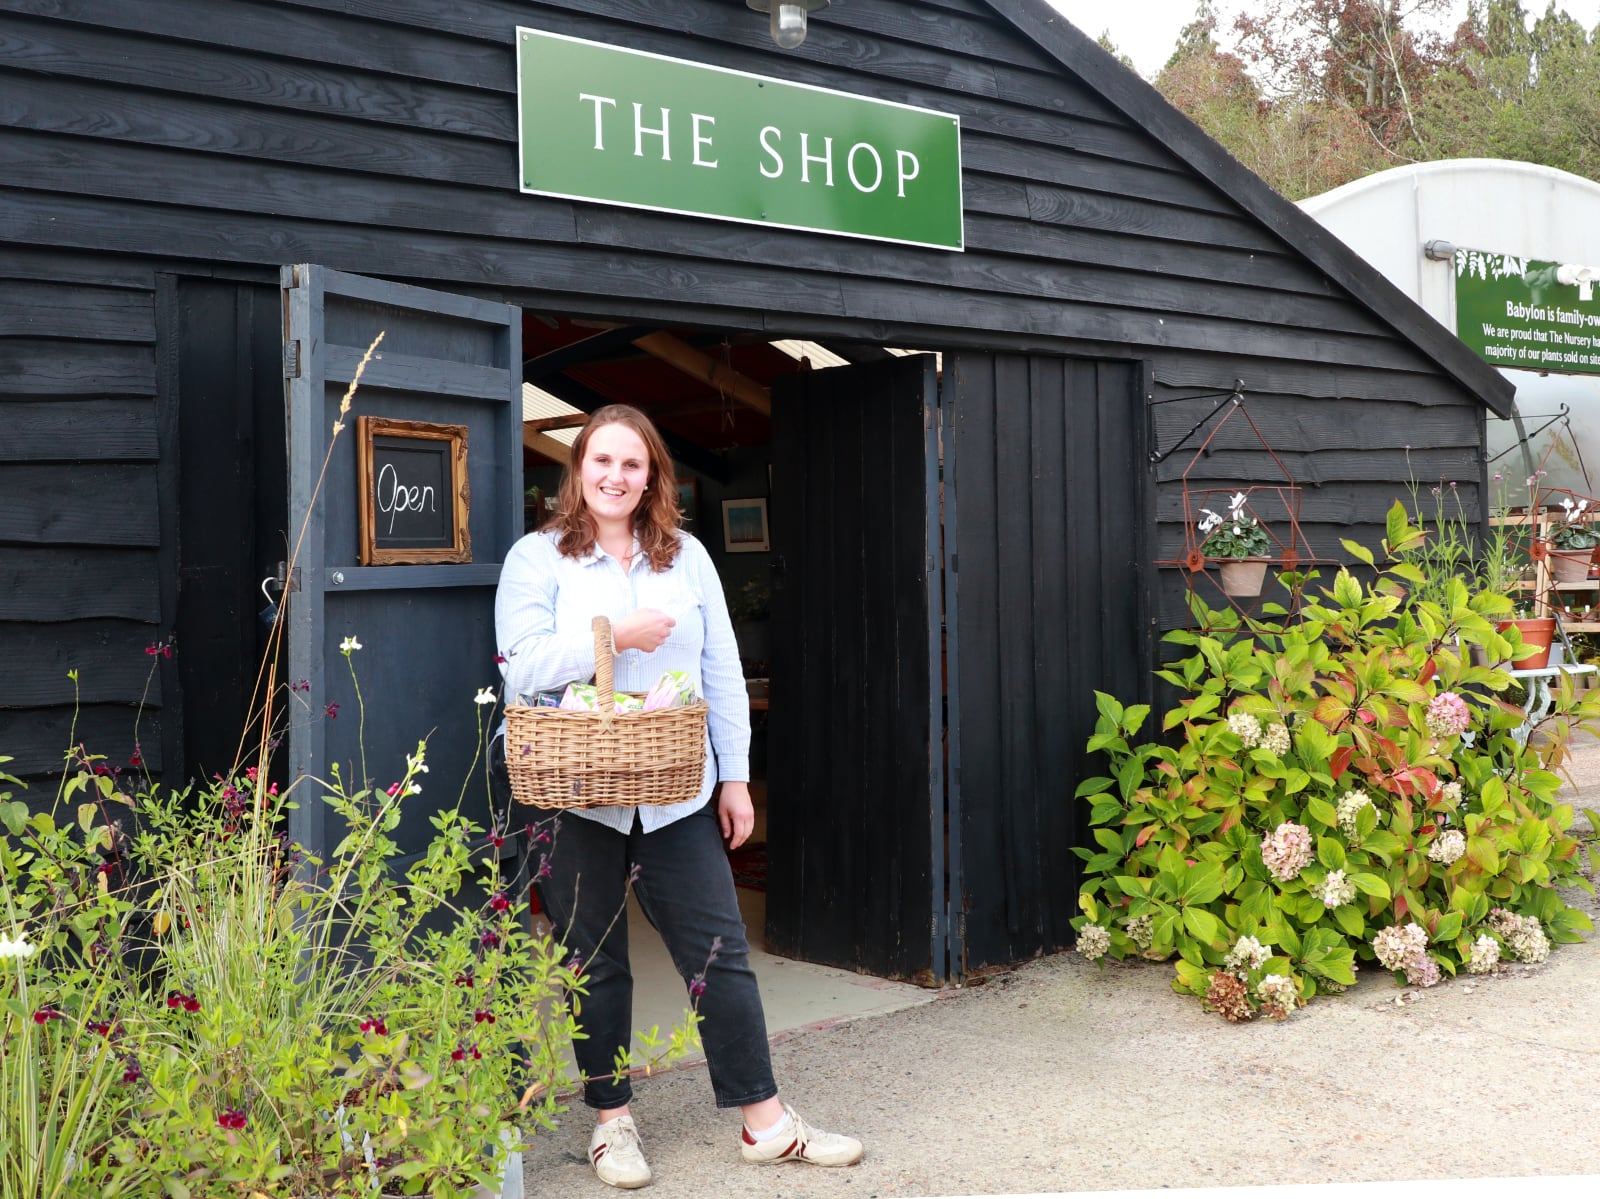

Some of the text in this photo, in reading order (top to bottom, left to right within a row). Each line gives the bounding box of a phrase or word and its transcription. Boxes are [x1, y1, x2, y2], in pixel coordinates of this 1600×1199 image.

[579, 93, 920, 198] THE SHOP
[1506, 300, 1545, 322] Babylon
[1547, 305, 1555, 322] is
[1482, 323, 1496, 337] We
[1497, 327, 1509, 338] are
[1510, 328, 1532, 342] proud
[1533, 329, 1548, 342] that
[1549, 330, 1563, 344] The
[1564, 332, 1591, 349] Nursery
[1485, 343, 1517, 360] majority
[1518, 346, 1527, 359] of
[1527, 349, 1541, 360] our
[1541, 348, 1563, 363] plants
[1563, 350, 1578, 363] sold
[1579, 354, 1589, 364] on
[377, 463, 436, 535] Open
